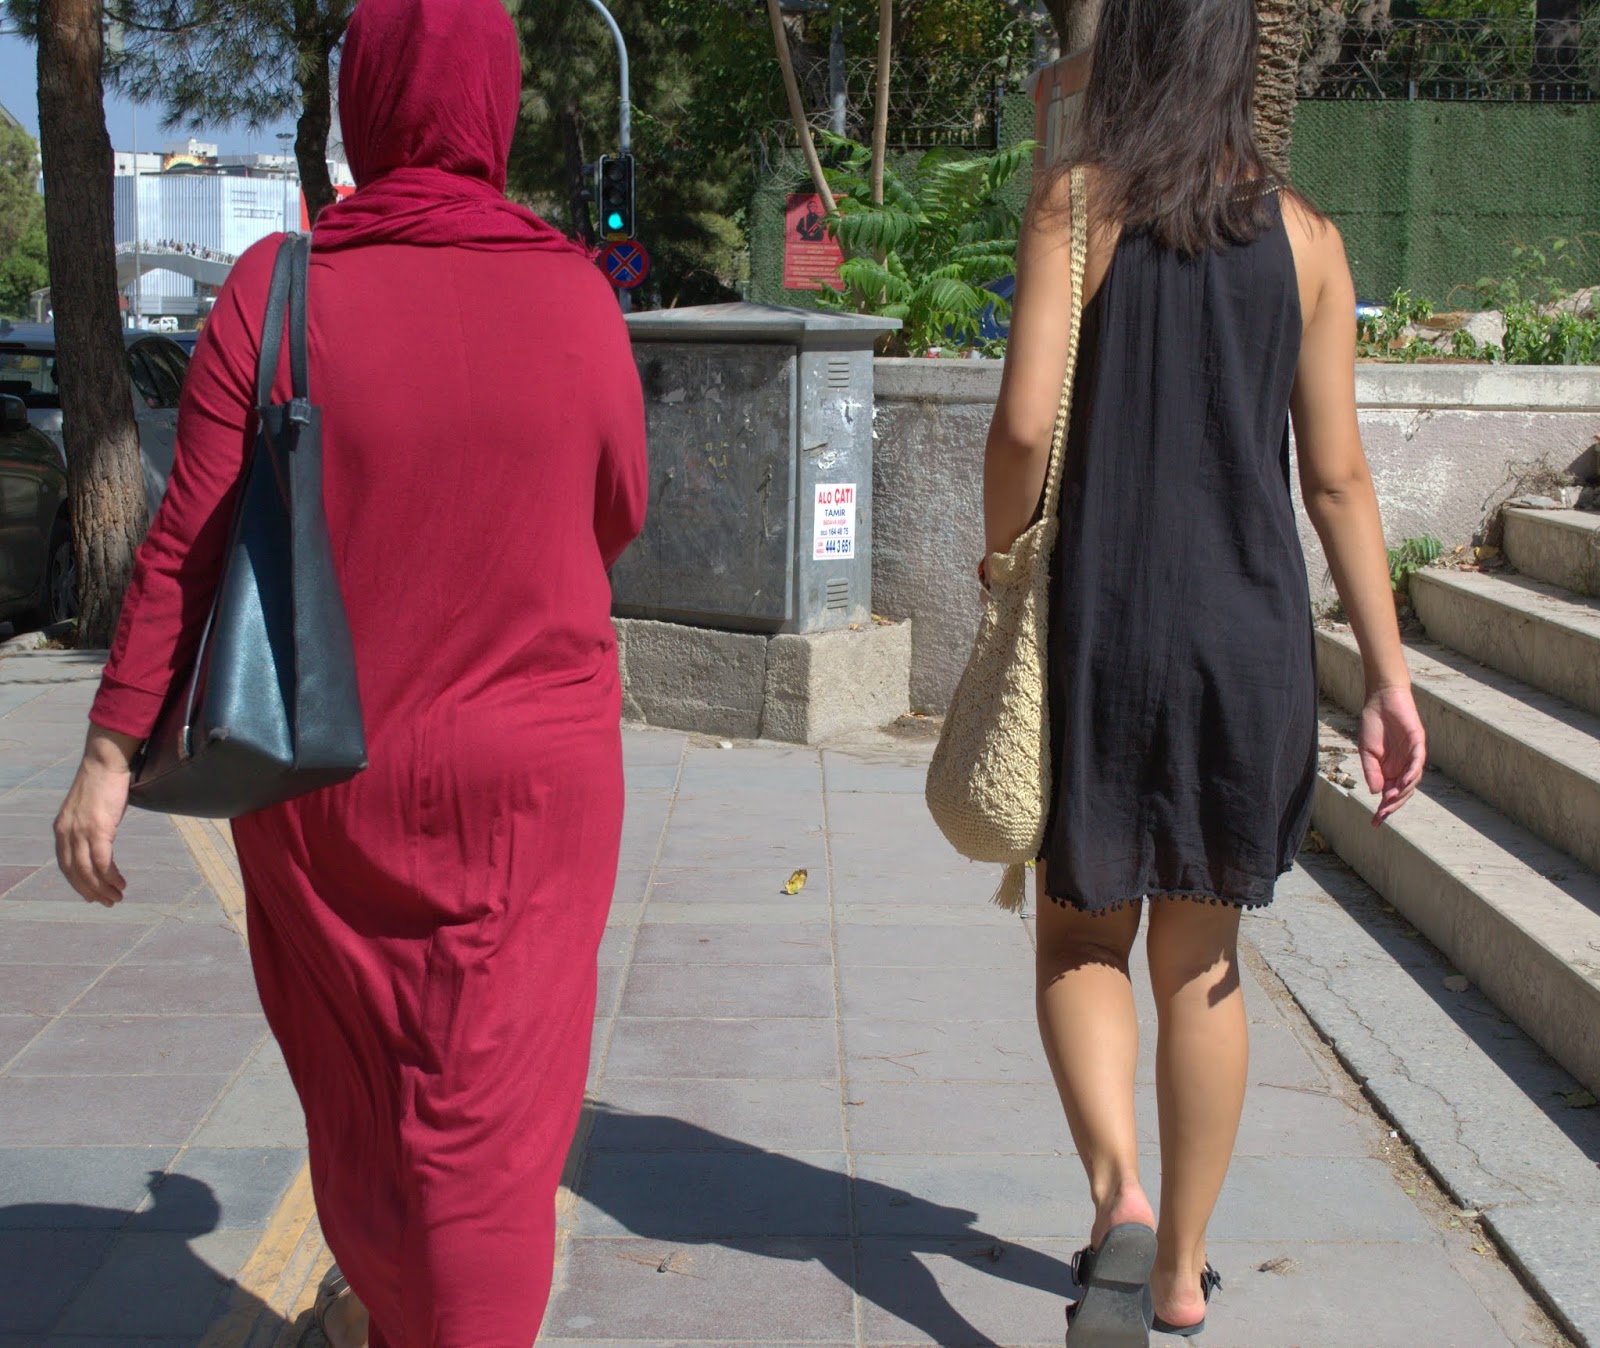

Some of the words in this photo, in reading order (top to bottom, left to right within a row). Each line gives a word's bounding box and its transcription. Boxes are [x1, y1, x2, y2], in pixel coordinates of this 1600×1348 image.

[818, 491, 832, 504] ALO
[834, 488, 853, 506] ÇATI
[825, 507, 846, 516] TAMİR
[825, 540, 836, 554] 444
[837, 540, 841, 553] 3
